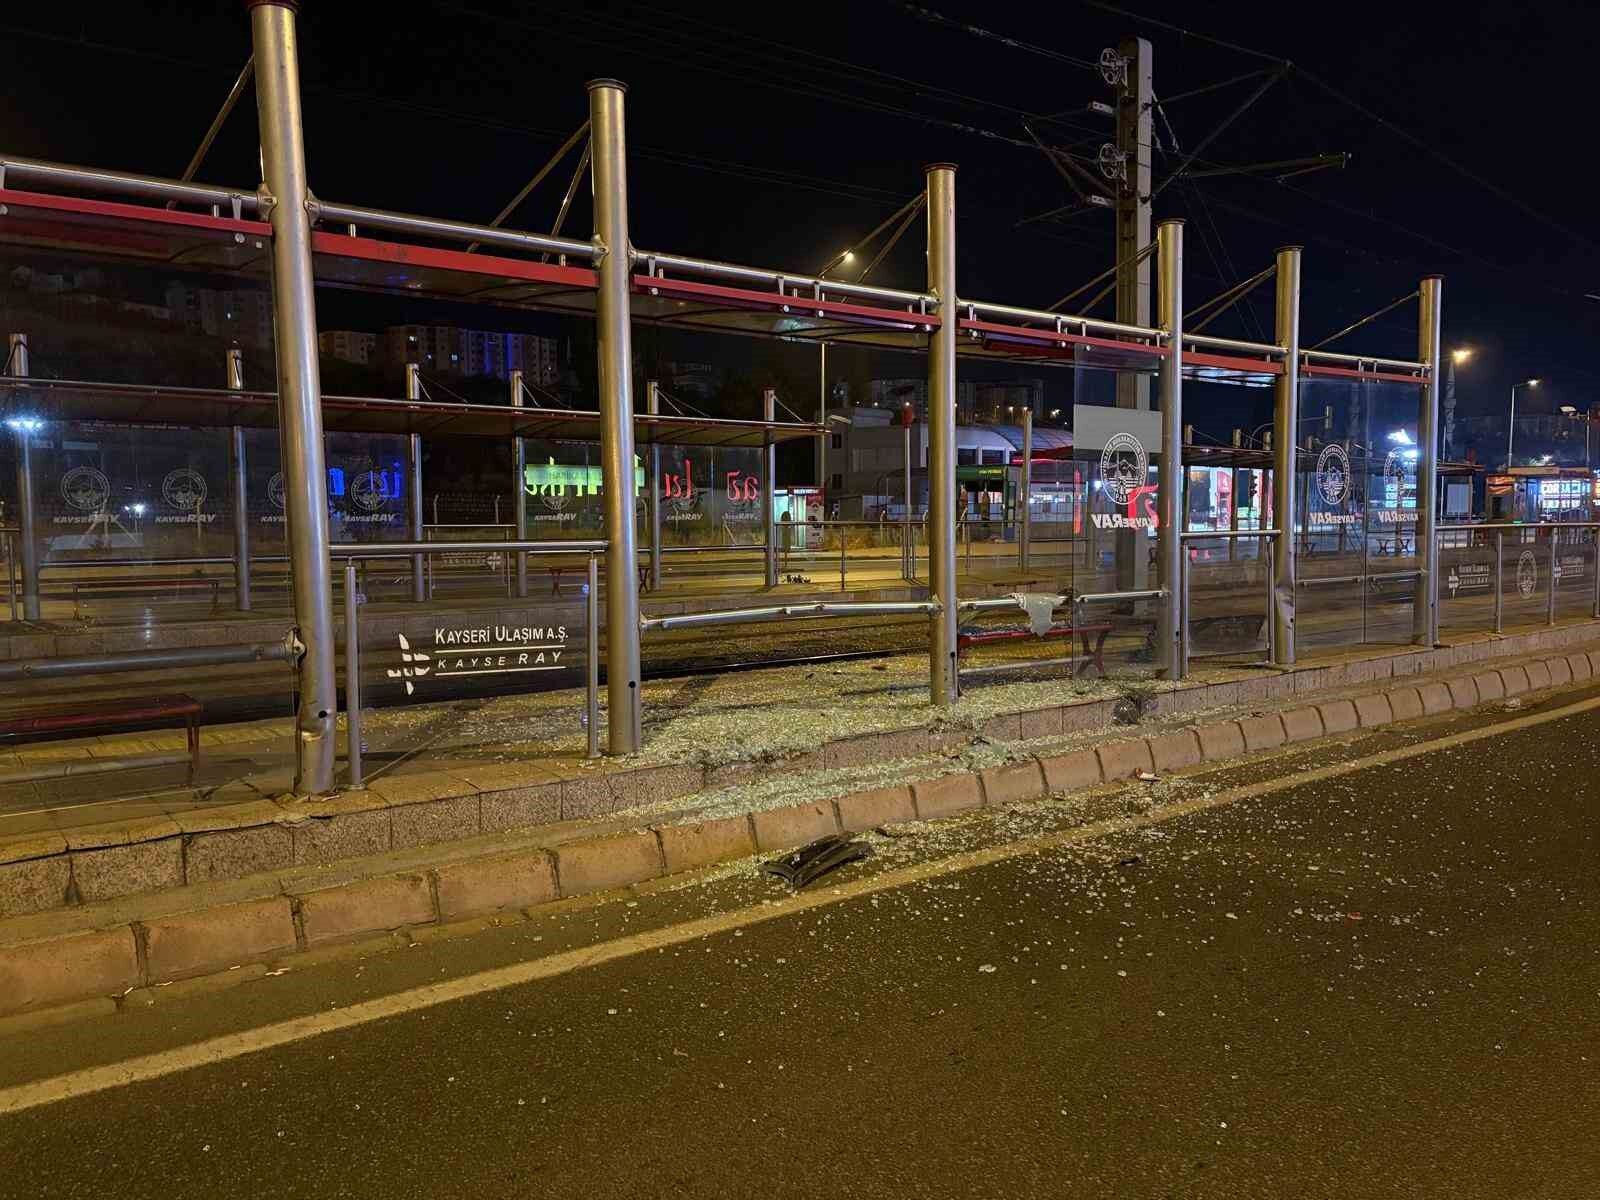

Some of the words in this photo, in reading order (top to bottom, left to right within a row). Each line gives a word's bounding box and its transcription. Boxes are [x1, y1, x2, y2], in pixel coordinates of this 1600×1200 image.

[435, 626, 491, 645] KAYSERİ
[495, 625, 543, 645] ULAŞIM
[546, 626, 569, 643] A.Ş.
